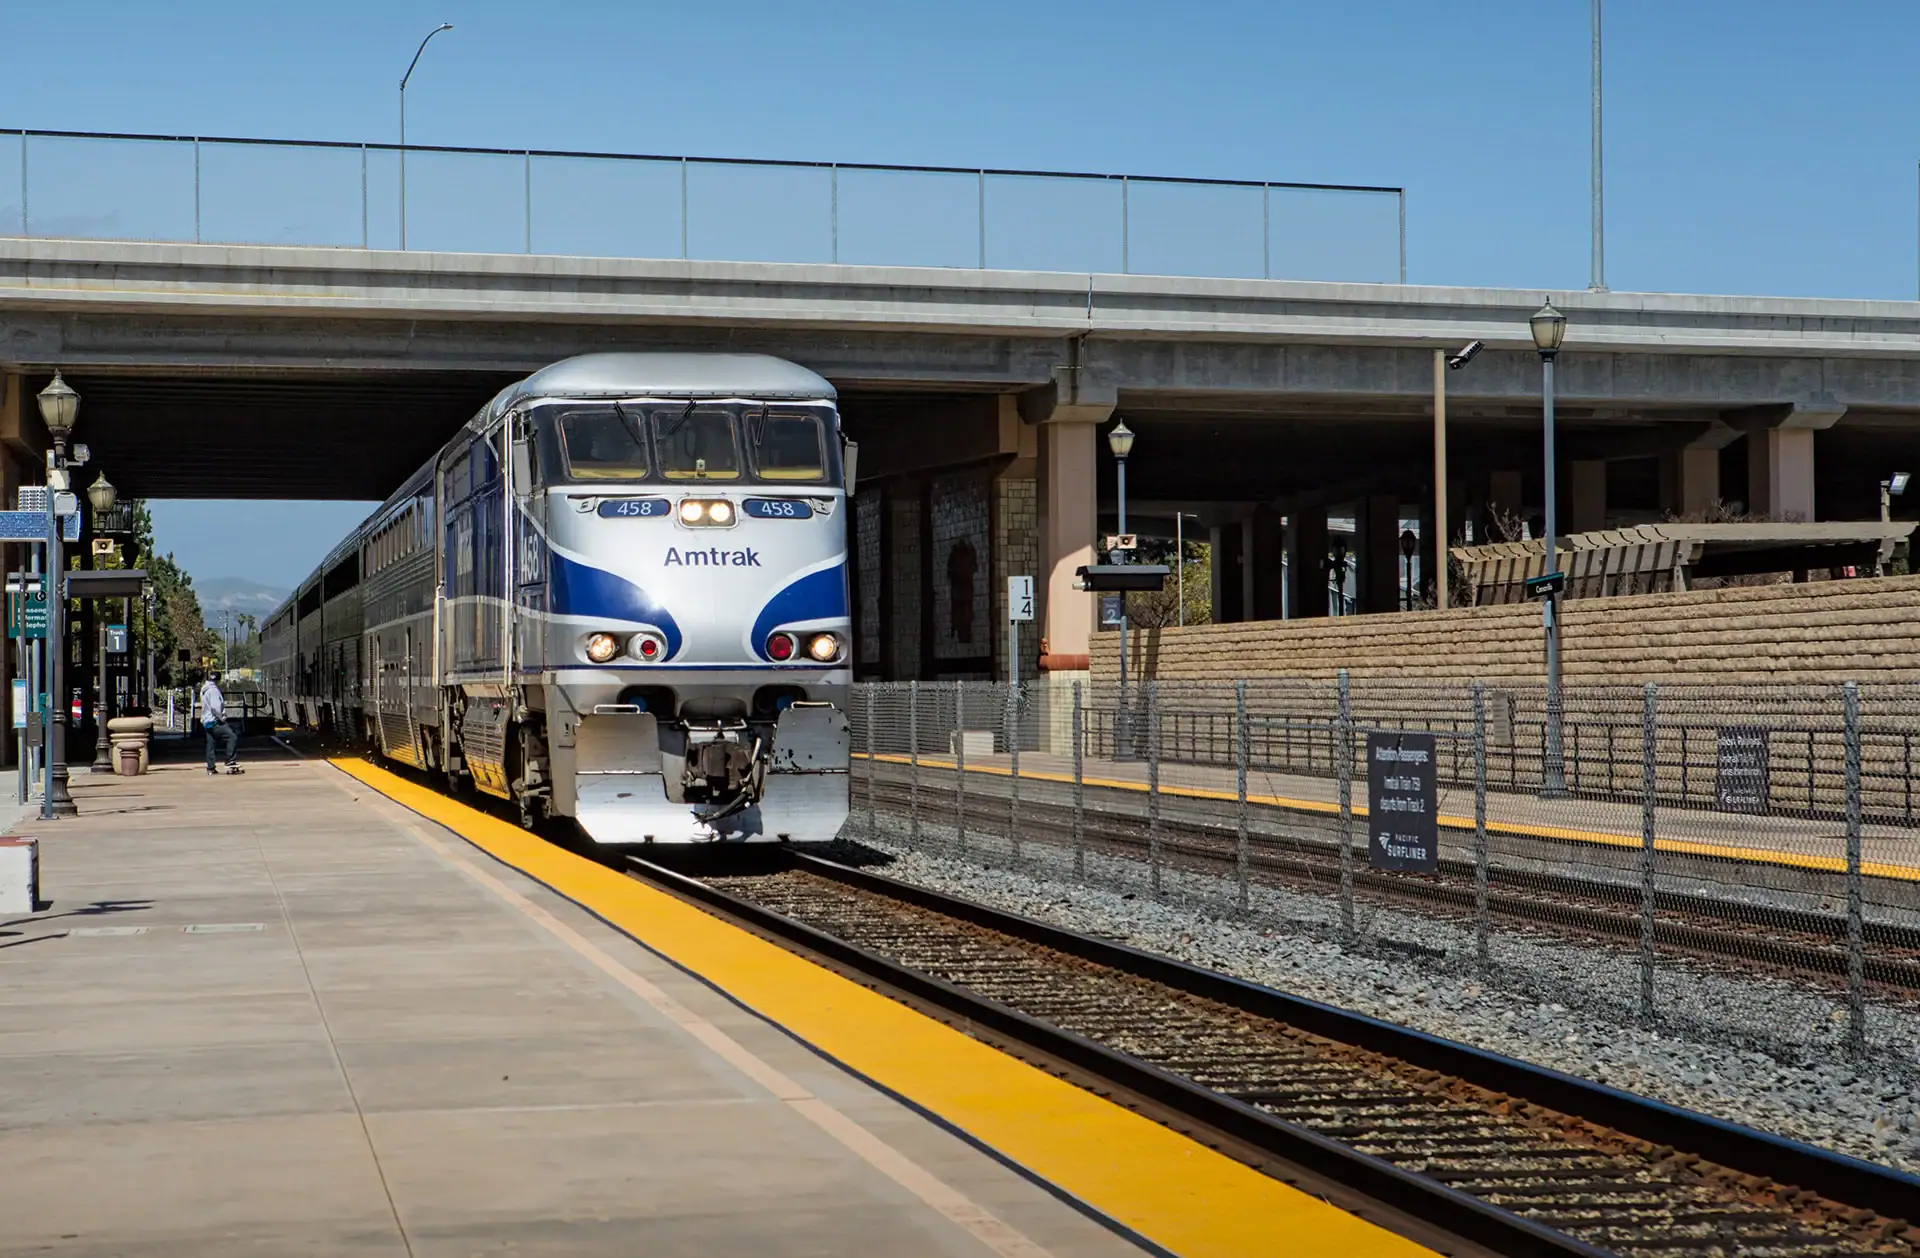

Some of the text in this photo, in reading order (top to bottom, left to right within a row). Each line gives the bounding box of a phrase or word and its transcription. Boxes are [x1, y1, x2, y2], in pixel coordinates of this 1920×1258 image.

[617, 502, 652, 515] 458
[761, 502, 795, 516] 458
[664, 547, 761, 567] Amtrak
[1107, 609, 1116, 622] 2
[114, 636, 120, 650] 1
[1395, 833, 1419, 844] PACIFIC
[1387, 844, 1427, 860] SURFLINER
